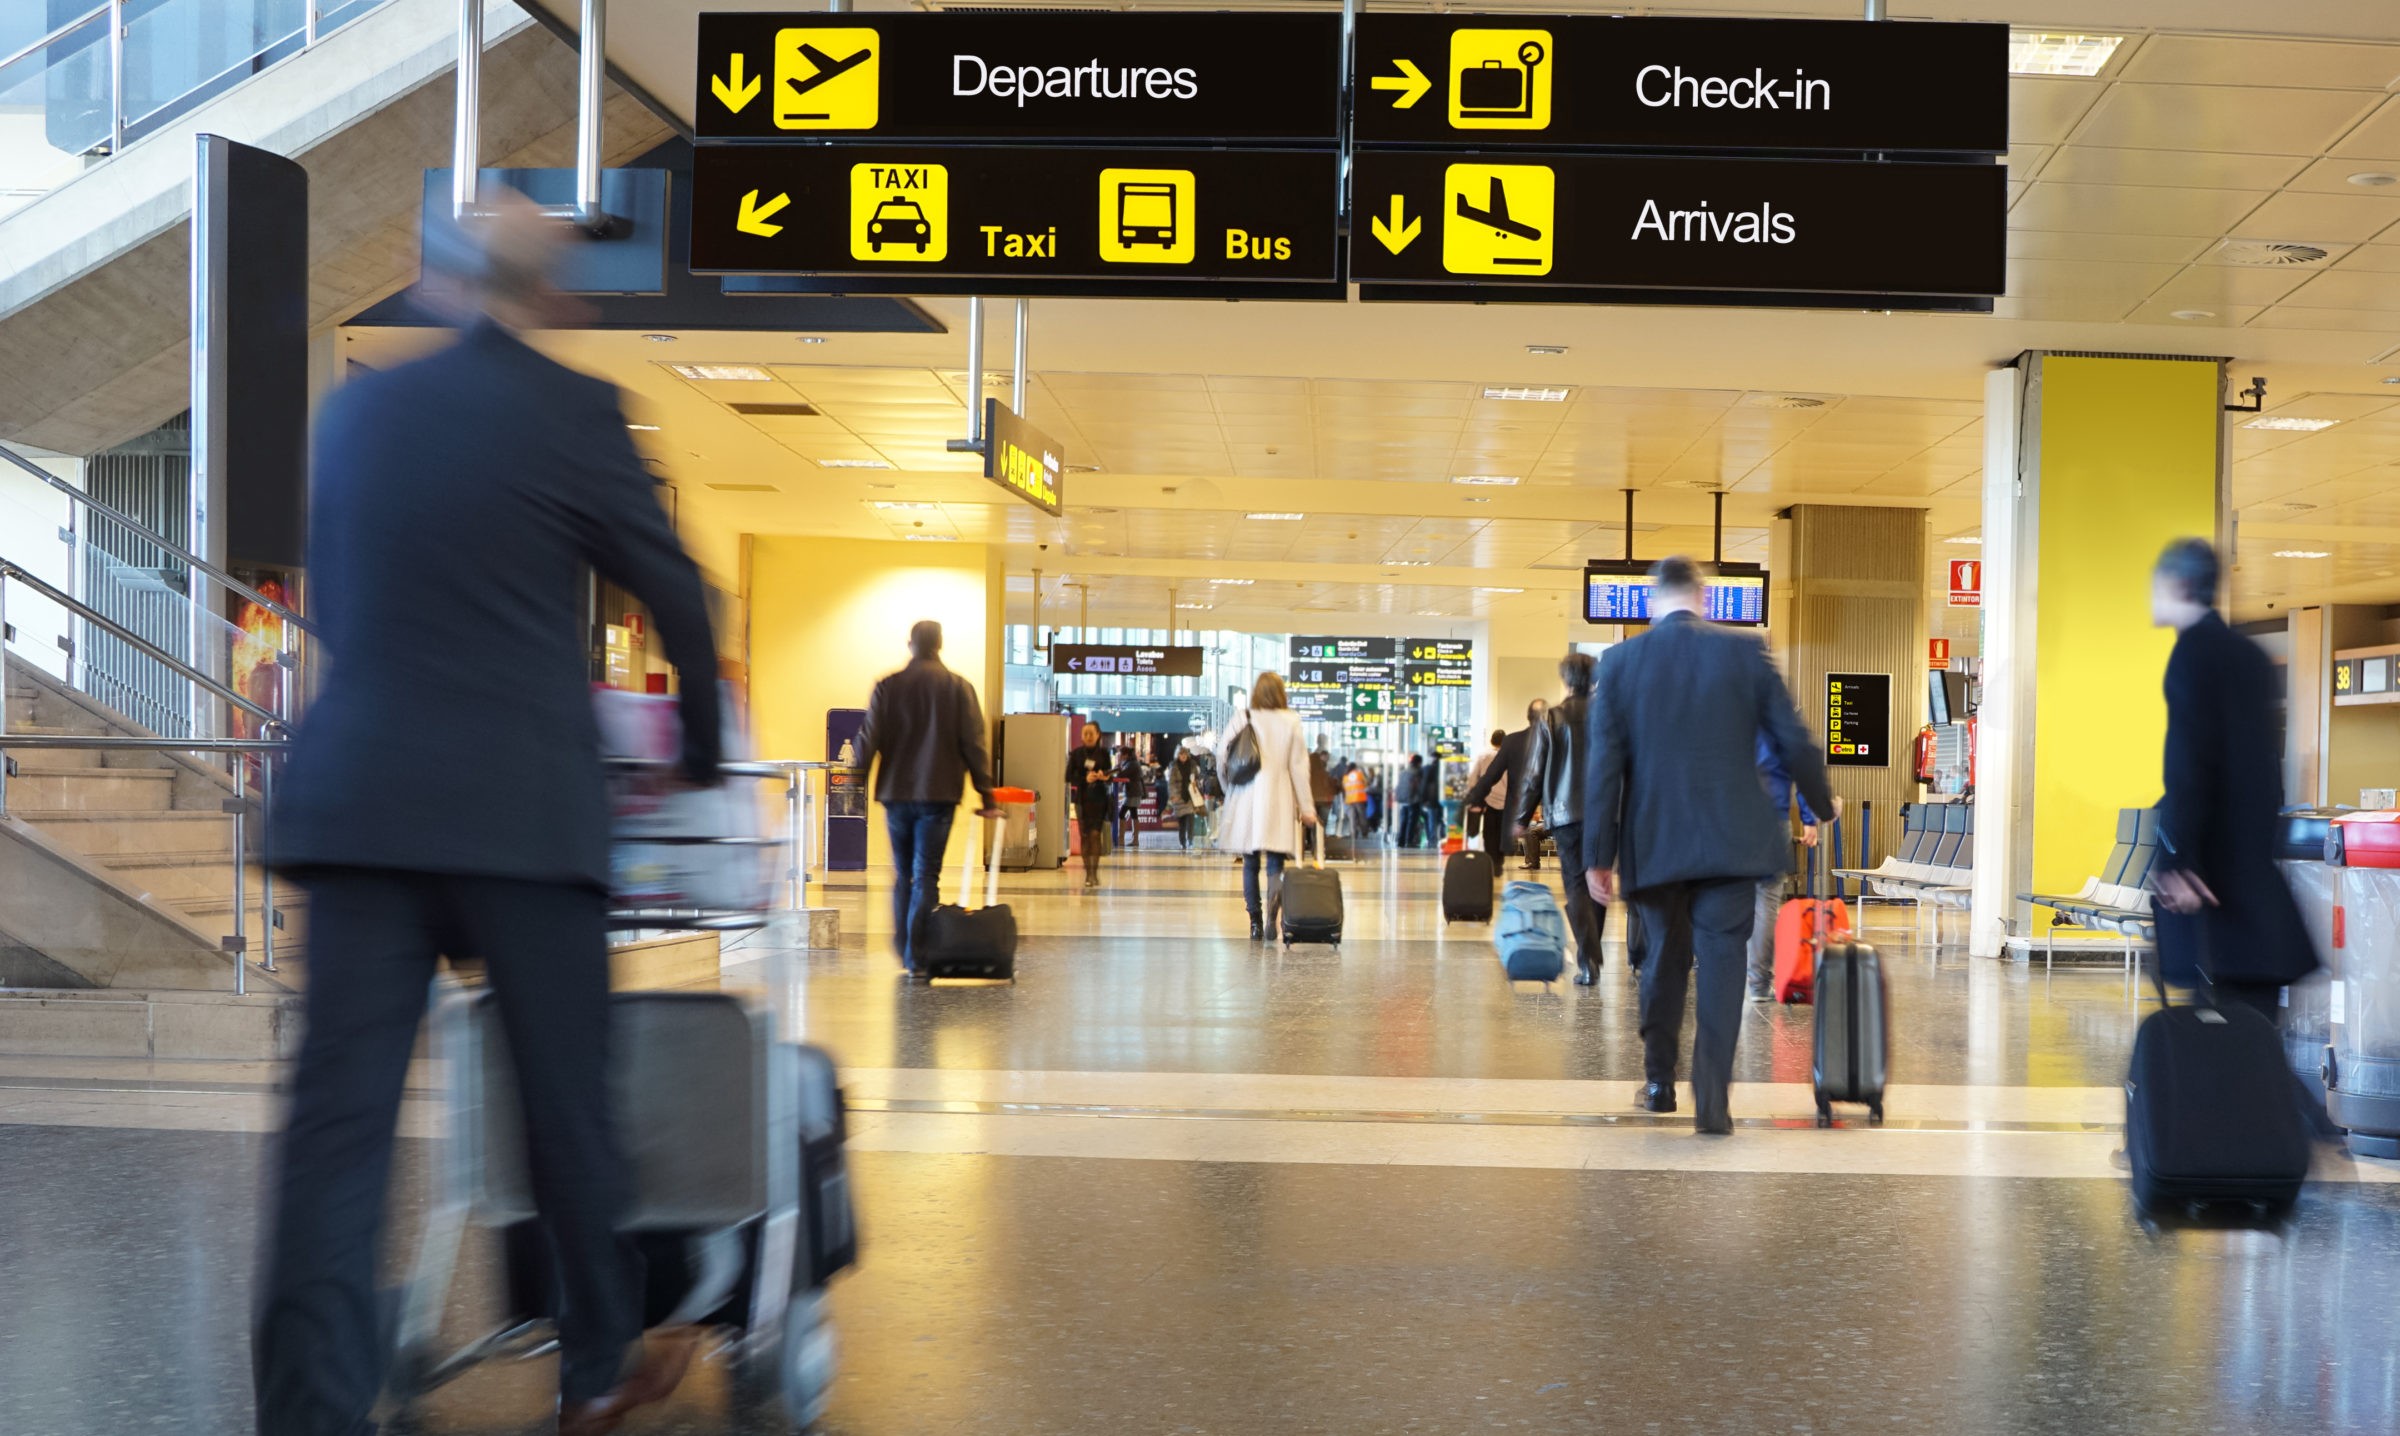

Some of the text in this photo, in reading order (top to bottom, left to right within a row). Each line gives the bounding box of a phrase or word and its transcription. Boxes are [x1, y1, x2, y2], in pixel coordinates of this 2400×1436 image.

[953, 54, 1198, 108] Departures
[1635, 64, 1830, 111] Check-in
[870, 168, 928, 190] TAXI
[1631, 199, 1796, 244] Arrivals
[979, 225, 1056, 258] Taxi
[1226, 228, 1291, 261] Bus
[1950, 595, 1980, 603] EXTINTOR
[2337, 665, 2350, 690] 38
